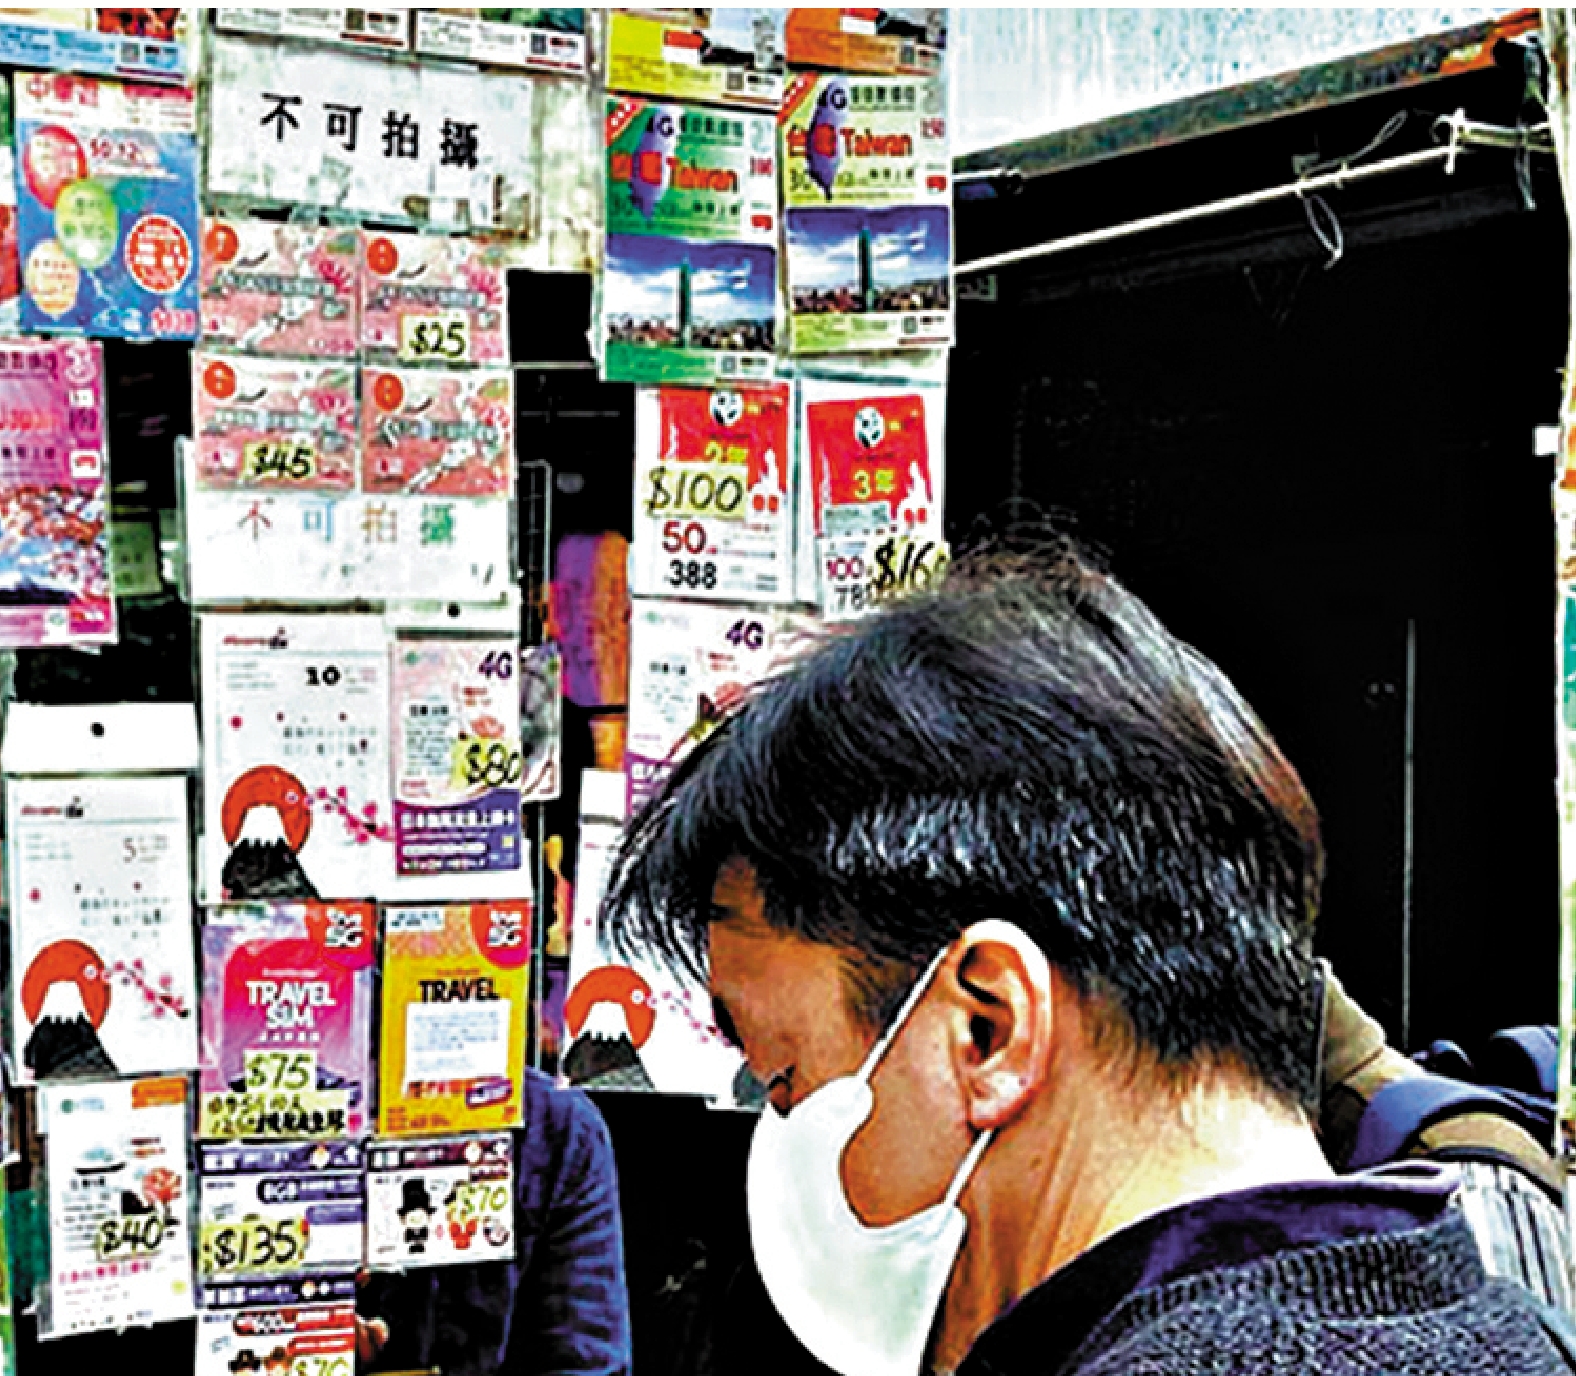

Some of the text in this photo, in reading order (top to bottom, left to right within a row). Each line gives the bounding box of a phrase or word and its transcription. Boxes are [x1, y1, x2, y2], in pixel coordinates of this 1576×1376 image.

[260, 91, 479, 170] 不可拍攝
[842, 127, 912, 157] Taiwan
[409, 321, 467, 356] $25
[252, 446, 314, 479] $45
[648, 466, 743, 516] $100
[237, 499, 456, 546] 不可拍攝
[662, 520, 706, 554] 50
[668, 560, 717, 590] 388
[726, 619, 764, 649] 4G
[305, 666, 341, 686] 10
[479, 651, 513, 680] 4G
[246, 981, 334, 1007] TRAVEL
[418, 980, 501, 1003] TRAVEL
[246, 1053, 312, 1089] $75
[214, 1220, 297, 1268] $135
